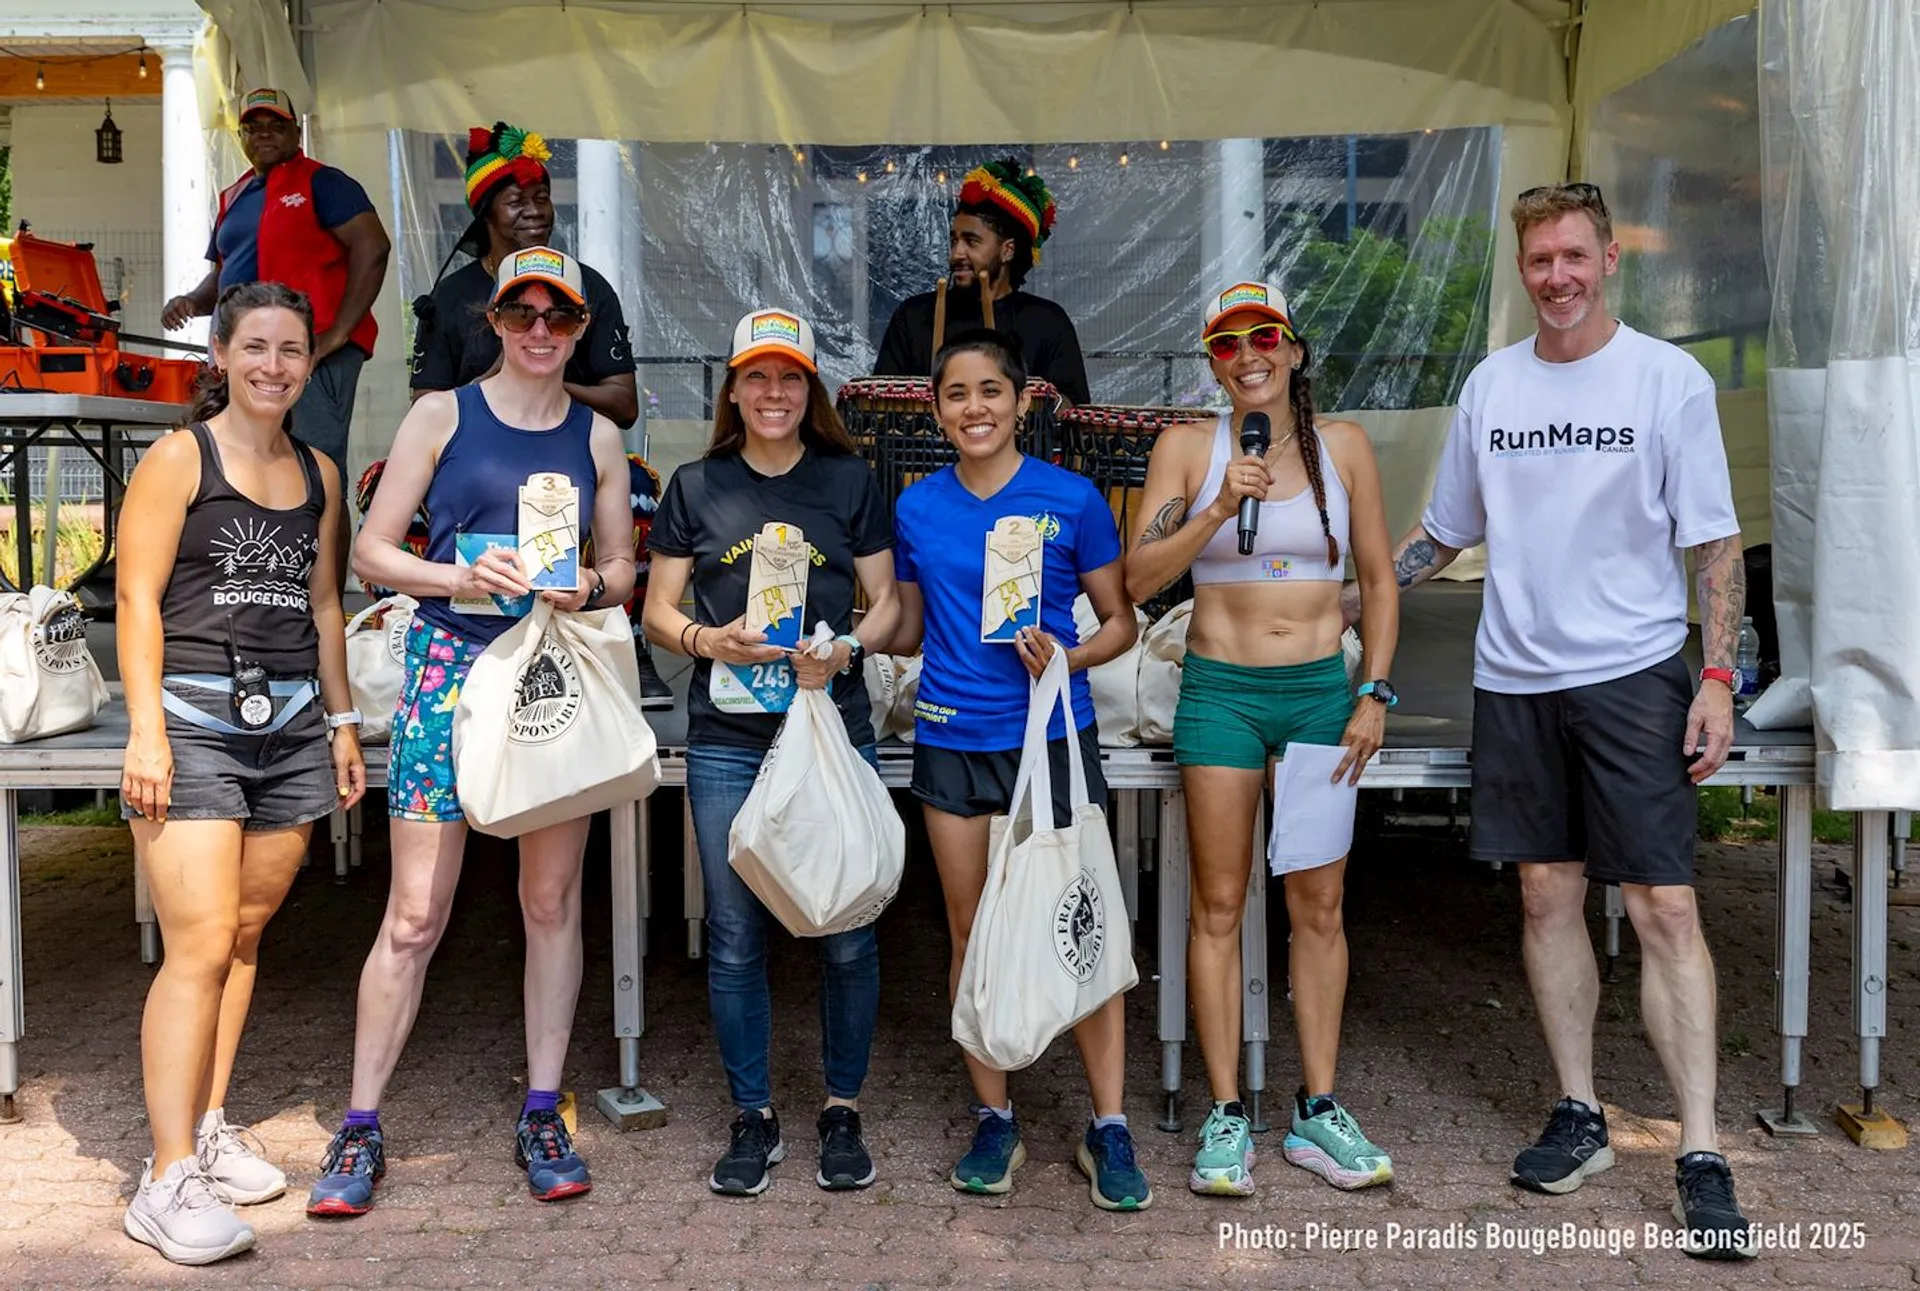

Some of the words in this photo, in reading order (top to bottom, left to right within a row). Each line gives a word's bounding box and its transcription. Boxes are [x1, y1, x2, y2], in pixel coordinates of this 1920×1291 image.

[1490, 422, 1635, 452] RunMaps
[542, 476, 556, 491] 3
[775, 525, 787, 546] 1
[1009, 521, 1022, 535] 2
[33, 639, 89, 670] RESPONSA
[541, 640, 574, 674] OCAL
[751, 664, 790, 688] 245
[512, 688, 580, 738] SPONSABLE
